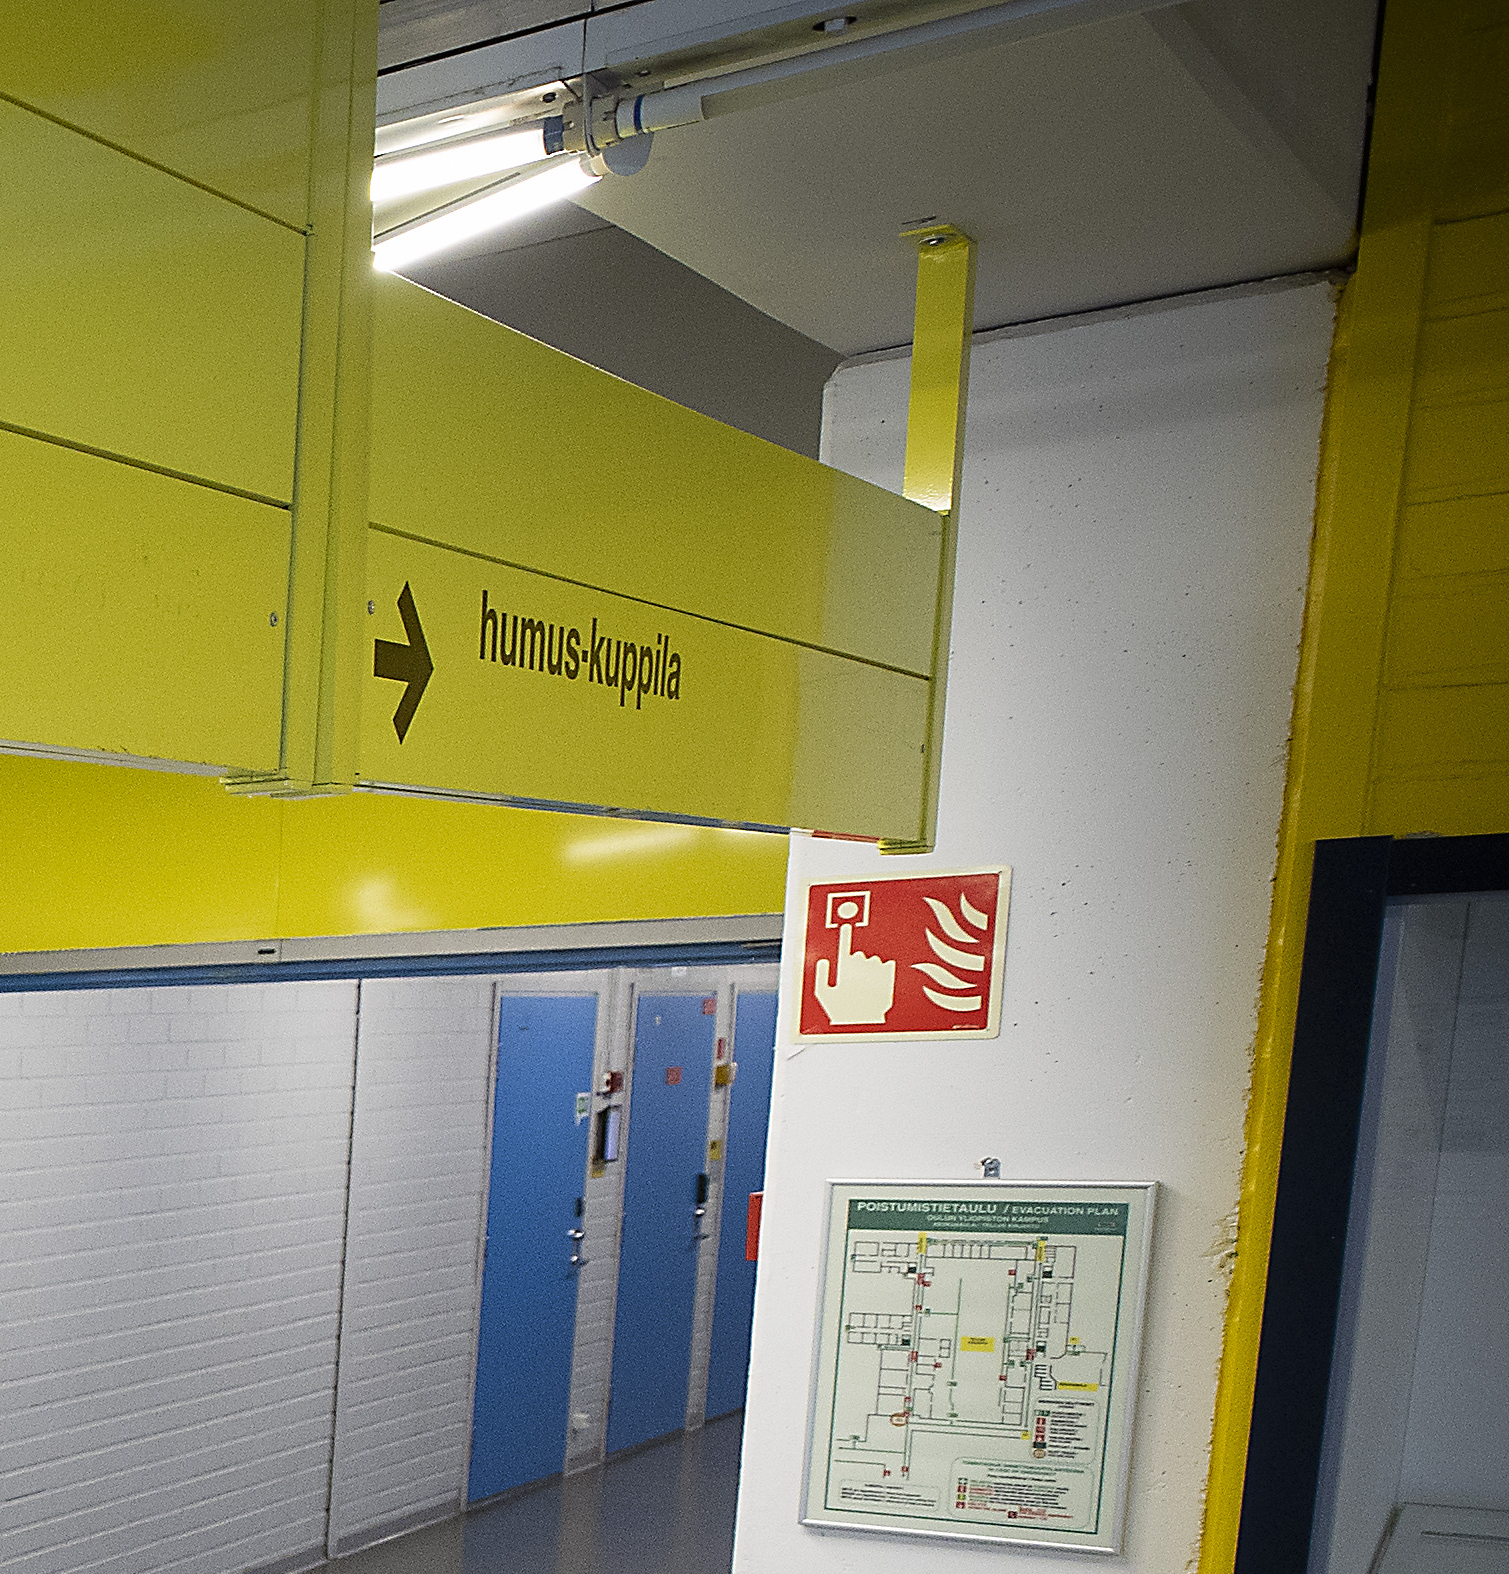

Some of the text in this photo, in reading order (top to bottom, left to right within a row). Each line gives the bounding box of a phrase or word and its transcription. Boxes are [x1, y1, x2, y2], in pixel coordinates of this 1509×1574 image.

[479, 589, 681, 710] humus-kuppila
[857, 1201, 998, 1214] POISTUMISTIETAULU
[1011, 1205, 1085, 1216] EVACUATION
[1087, 1206, 1120, 1217] PLAN
